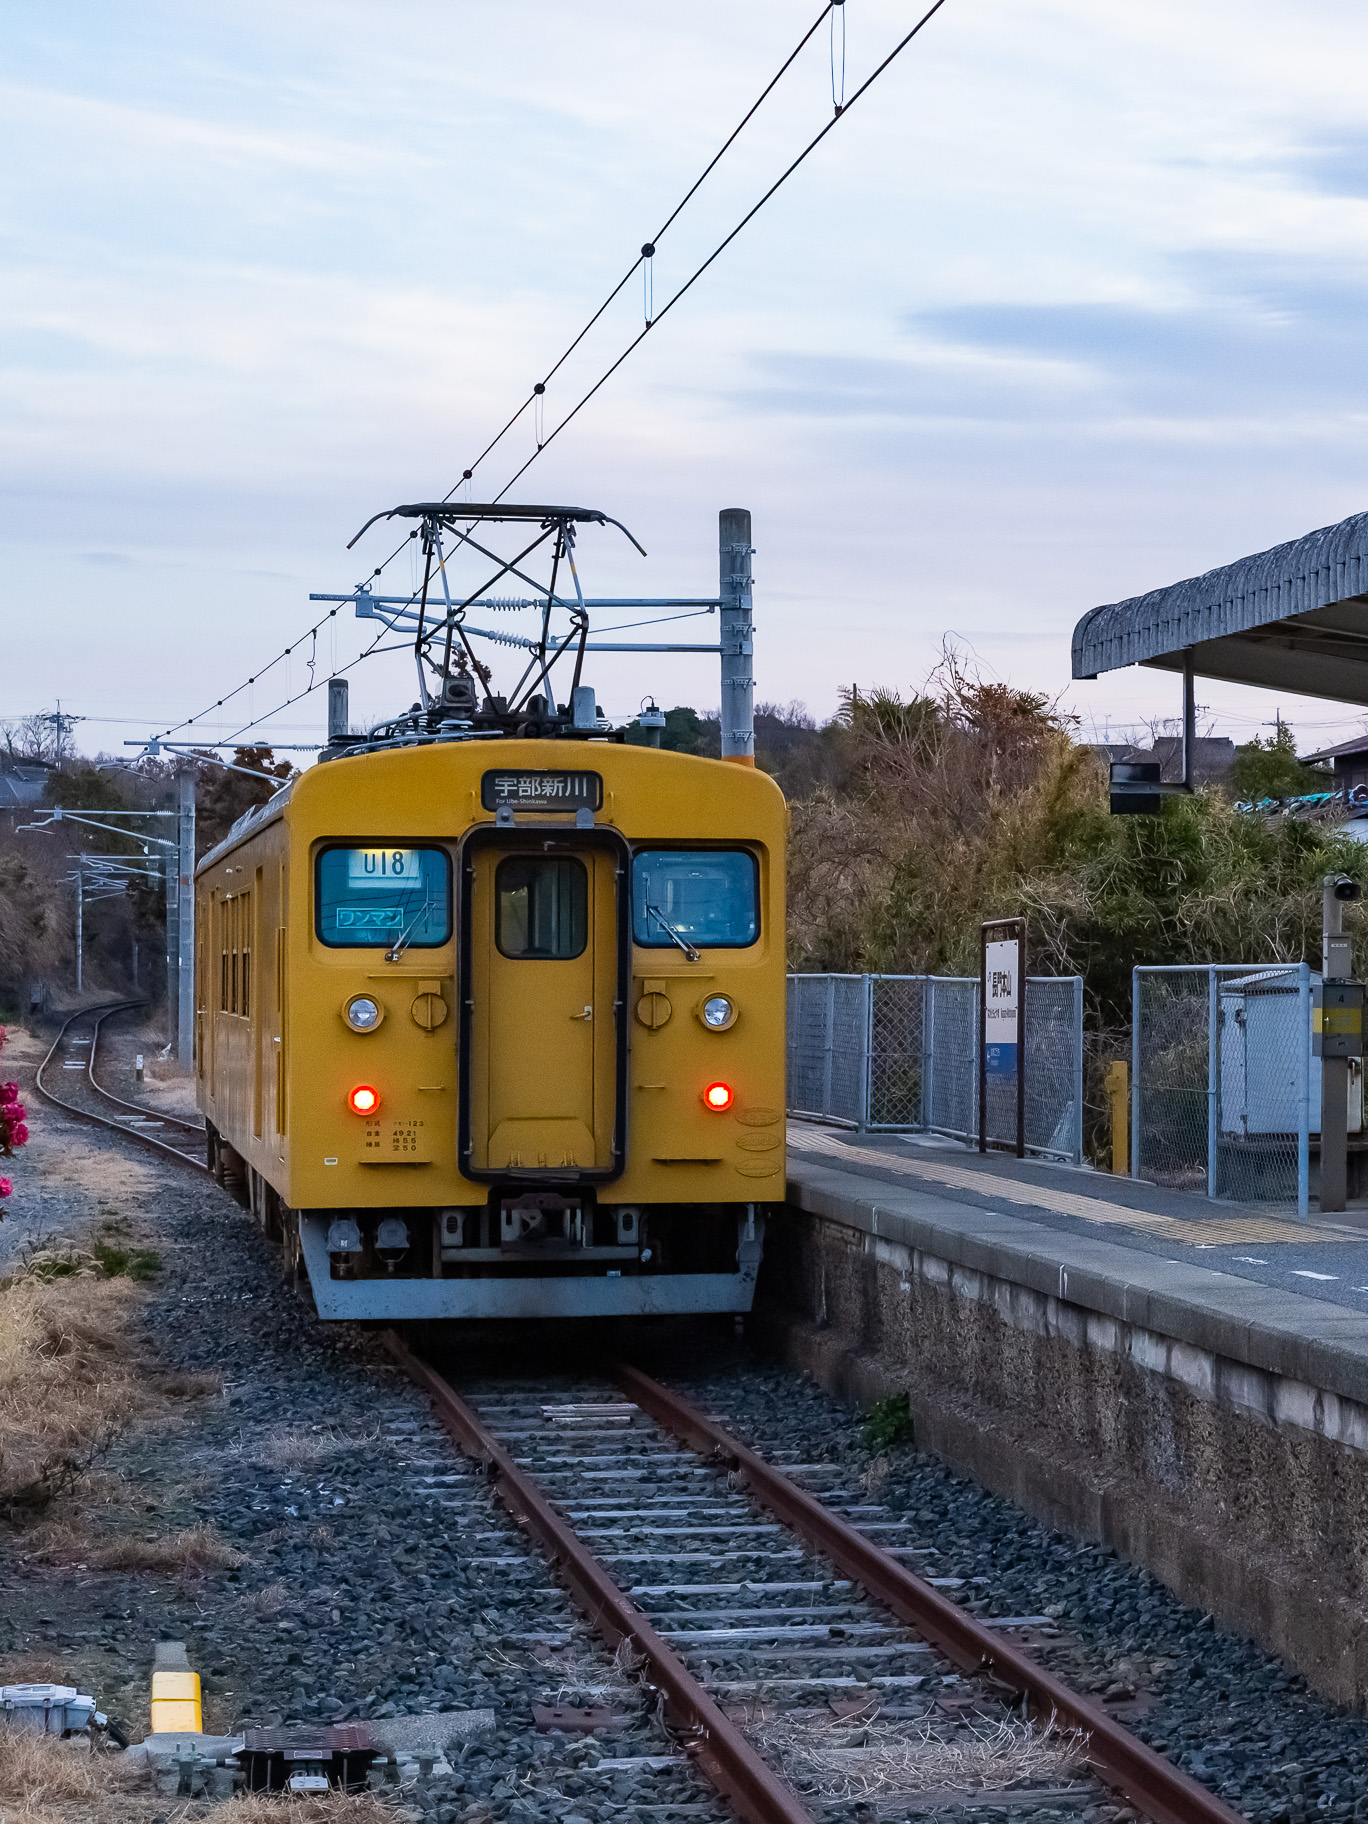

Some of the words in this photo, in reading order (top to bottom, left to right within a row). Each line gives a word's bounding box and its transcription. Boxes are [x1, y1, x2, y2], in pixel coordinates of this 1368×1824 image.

[495, 777, 587, 797] 宇部新川
[364, 851, 404, 875] U18
[340, 911, 400, 926] ワンマン
[1338, 994, 1345, 1003] 4
[1331, 1015, 1351, 1027] JR
